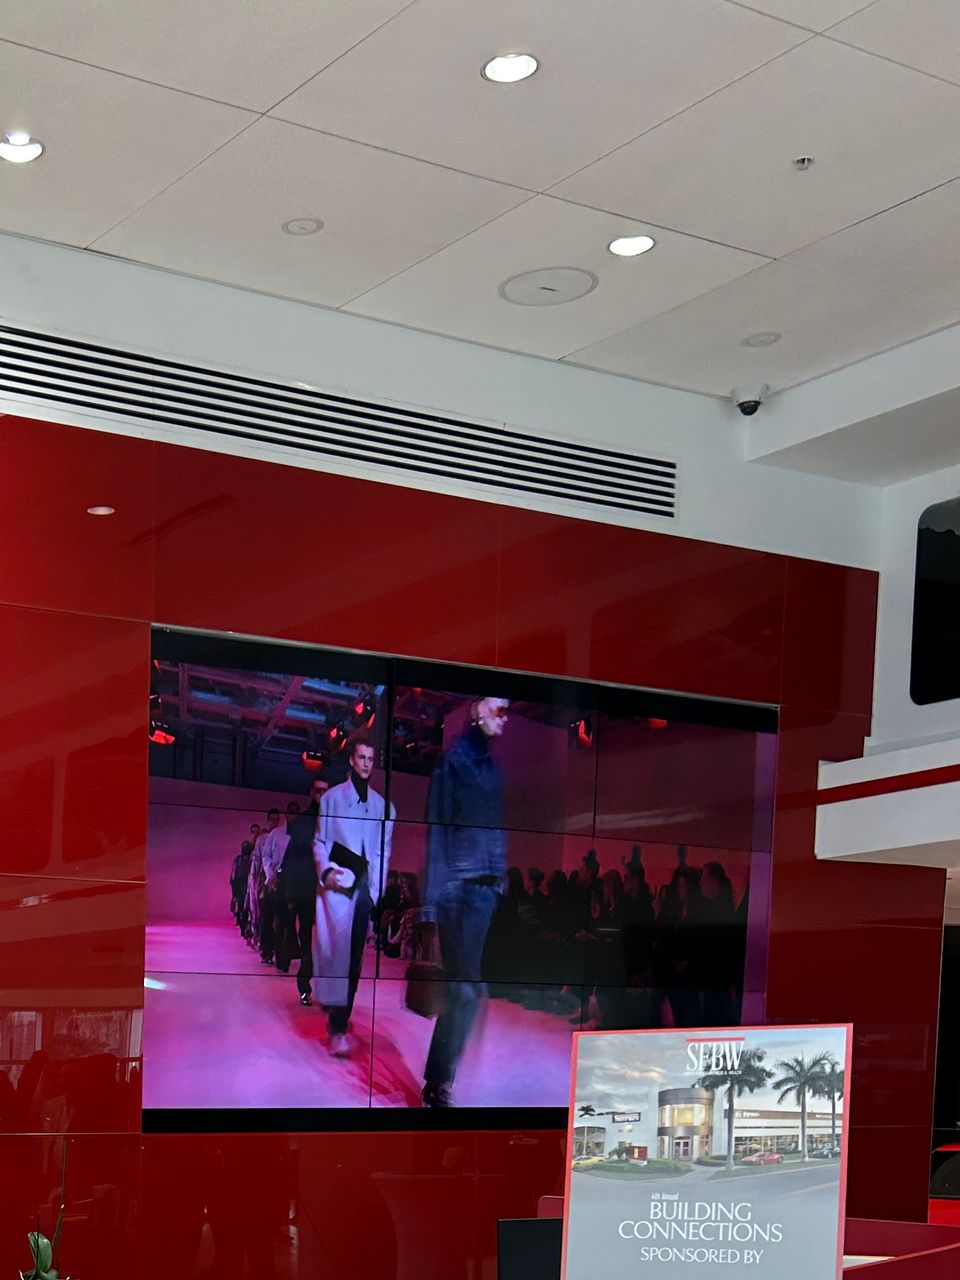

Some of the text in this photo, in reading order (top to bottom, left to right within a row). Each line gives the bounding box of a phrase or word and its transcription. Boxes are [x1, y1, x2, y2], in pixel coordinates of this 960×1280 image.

[686, 1041, 744, 1071] SFBW
[650, 1201, 751, 1221] BUILDING
[618, 1220, 783, 1242] CONNECTIONS
[640, 1246, 764, 1264] SPONSORED BY
